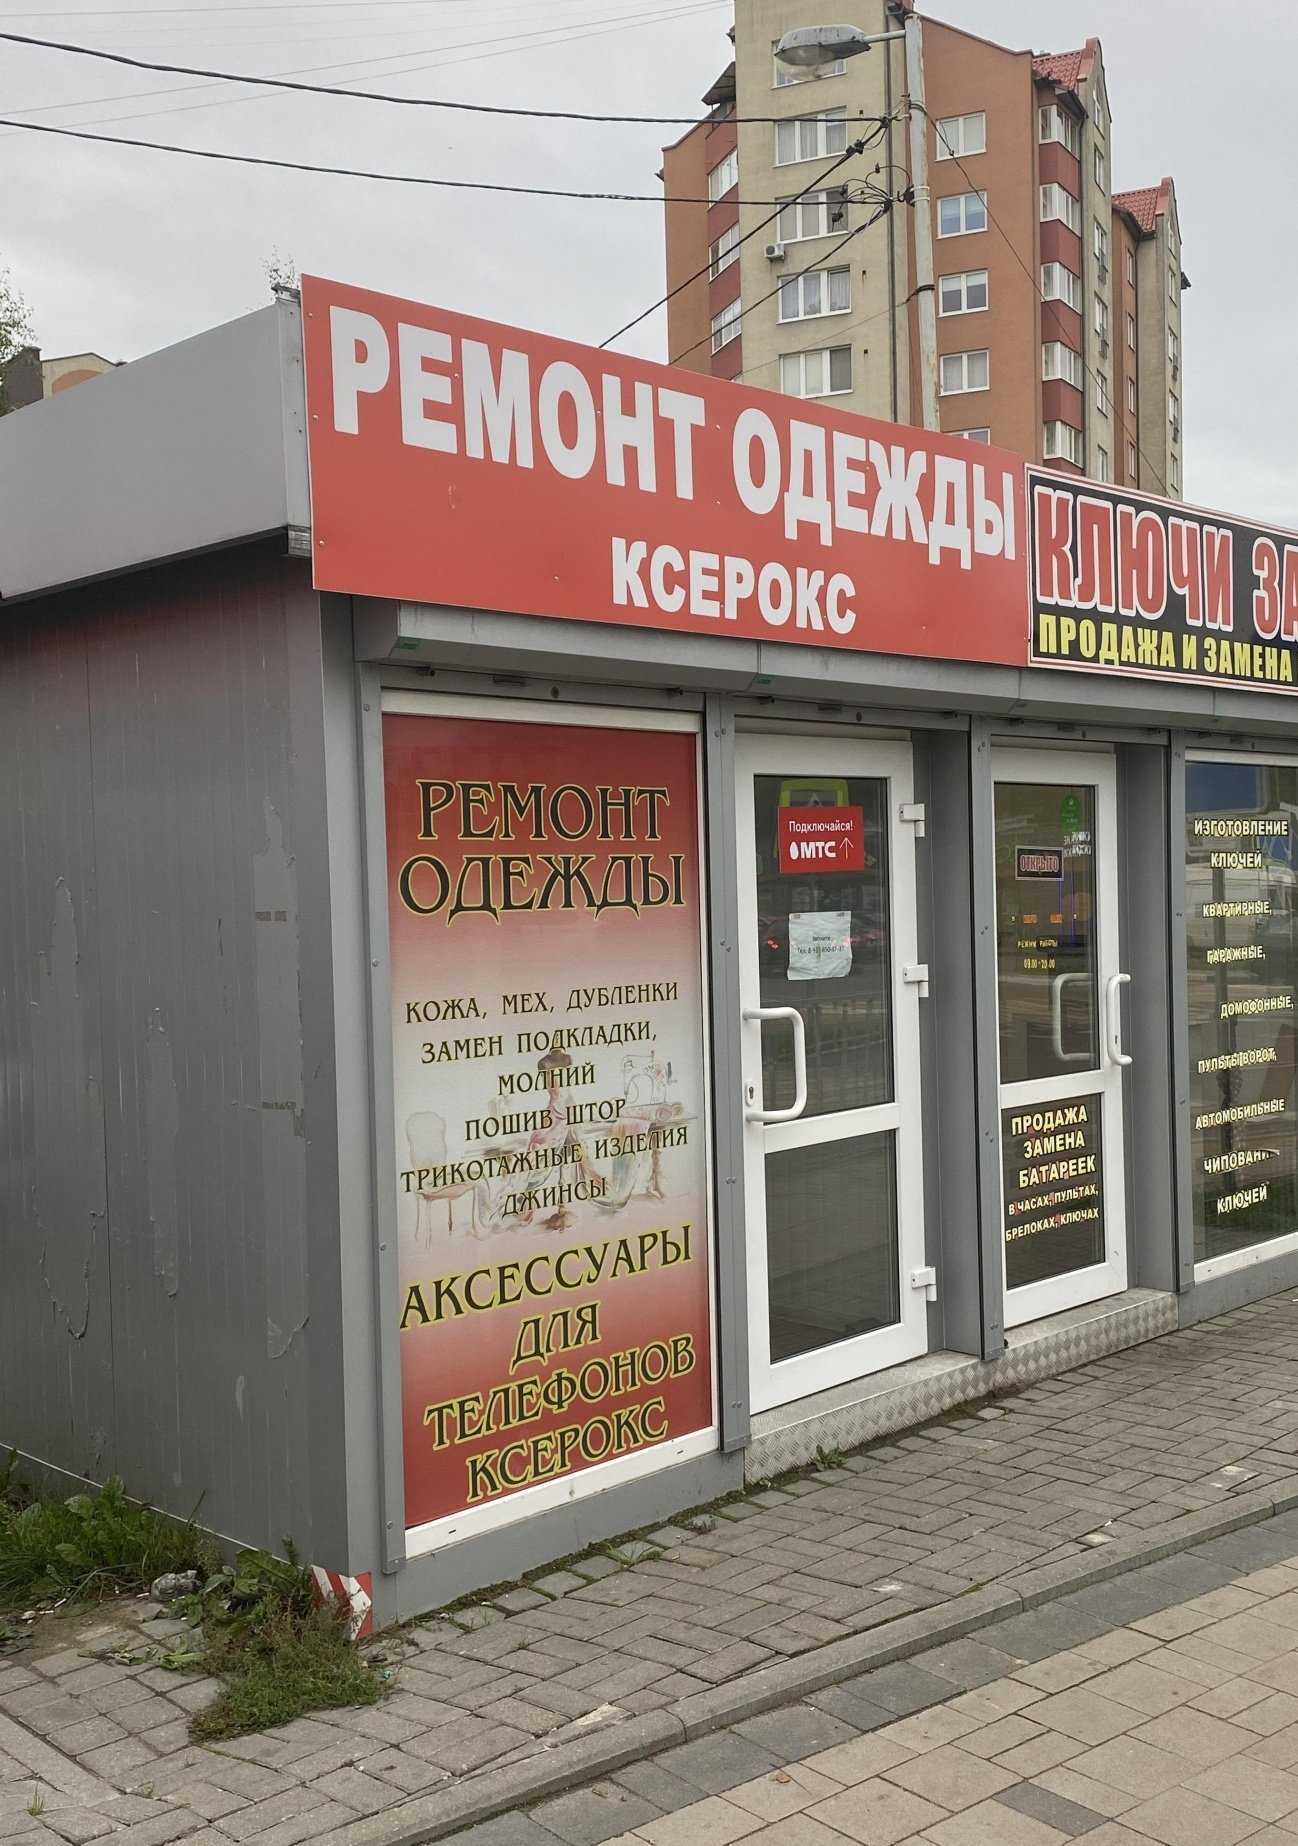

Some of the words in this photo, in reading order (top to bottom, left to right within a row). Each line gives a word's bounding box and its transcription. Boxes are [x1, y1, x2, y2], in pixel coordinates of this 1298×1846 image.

[329, 305, 705, 500] РЕМОНТ
[732, 407, 1017, 571] ОДЕЖДЫ
[1034, 485, 1233, 632] КЛЮЧИ
[611, 537, 857, 635] КСЕРОКС
[1039, 614, 1176, 668] ПРОДАЖА
[1182, 634, 1197, 670] И
[1204, 637, 1293, 682] ЗАМЕНА
[416, 779, 670, 841] РЕМОНТ
[789, 820, 854, 833] Подключайся!
[1194, 819, 1288, 836] ИЗГОТОВЛЕНИЕ
[801, 841, 837, 859] МТС
[1019, 855, 1059, 873] ОТКРЫТО
[1210, 851, 1262, 868] КЛЮЧЕЙ
[399, 854, 685, 928] ОДЕЖДЫ
[1203, 901, 1272, 918] КВАРТИРНЫЕ,
[1207, 945, 1266, 963] ГАРАЖНЫЕ,
[406, 998, 488, 1024] КОЖА,
[502, 992, 555, 1016] МЕХ,
[567, 982, 679, 1011] ДУБЛЕНКИ
[1220, 995, 1294, 1019] ДОМОФОННЫЕ,
[421, 1035, 503, 1064] ЗАМЕН
[517, 1021, 657, 1054] ПОДКЛАДКИ,
[498, 1062, 595, 1096] МОЛНИЙ
[1198, 1052, 1240, 1073] ПУЛЬТЫ
[464, 1107, 553, 1141] ПОШИВ
[566, 1098, 626, 1126] ШТОР
[1012, 1105, 1088, 1135] ПРОДАЖА
[1195, 1099, 1285, 1130] АВТОМОБИЛЬНЫЕ
[400, 1143, 582, 1193] ТРИКОТАЖНЫЕ
[595, 1126, 688, 1160] ИЗДЕЛИЯ
[1024, 1130, 1085, 1159] ЗАМЕНА
[1019, 1155, 1096, 1189] БАТАРЕЕК
[502, 1177, 607, 1219] ДЖИНСЫ
[1008, 1203, 1015, 1216] В
[1017, 1195, 1052, 1213] ЧАСАХ,
[1054, 1184, 1099, 1204] ПУЛЬТАХ,
[1217, 1183, 1268, 1214] КЛЮЧЕЙ
[1005, 1218, 1058, 1242] БРЕЛОКАХ,
[1060, 1208, 1100, 1226] КЛЮЧАХ
[400, 1224, 692, 1330] АКСЕССУАРЫ
[510, 1301, 600, 1374] ДЛЯ
[424, 1334, 695, 1451] ТЕЛЕФОНОВ
[466, 1398, 669, 1502] КСЕРОКС
